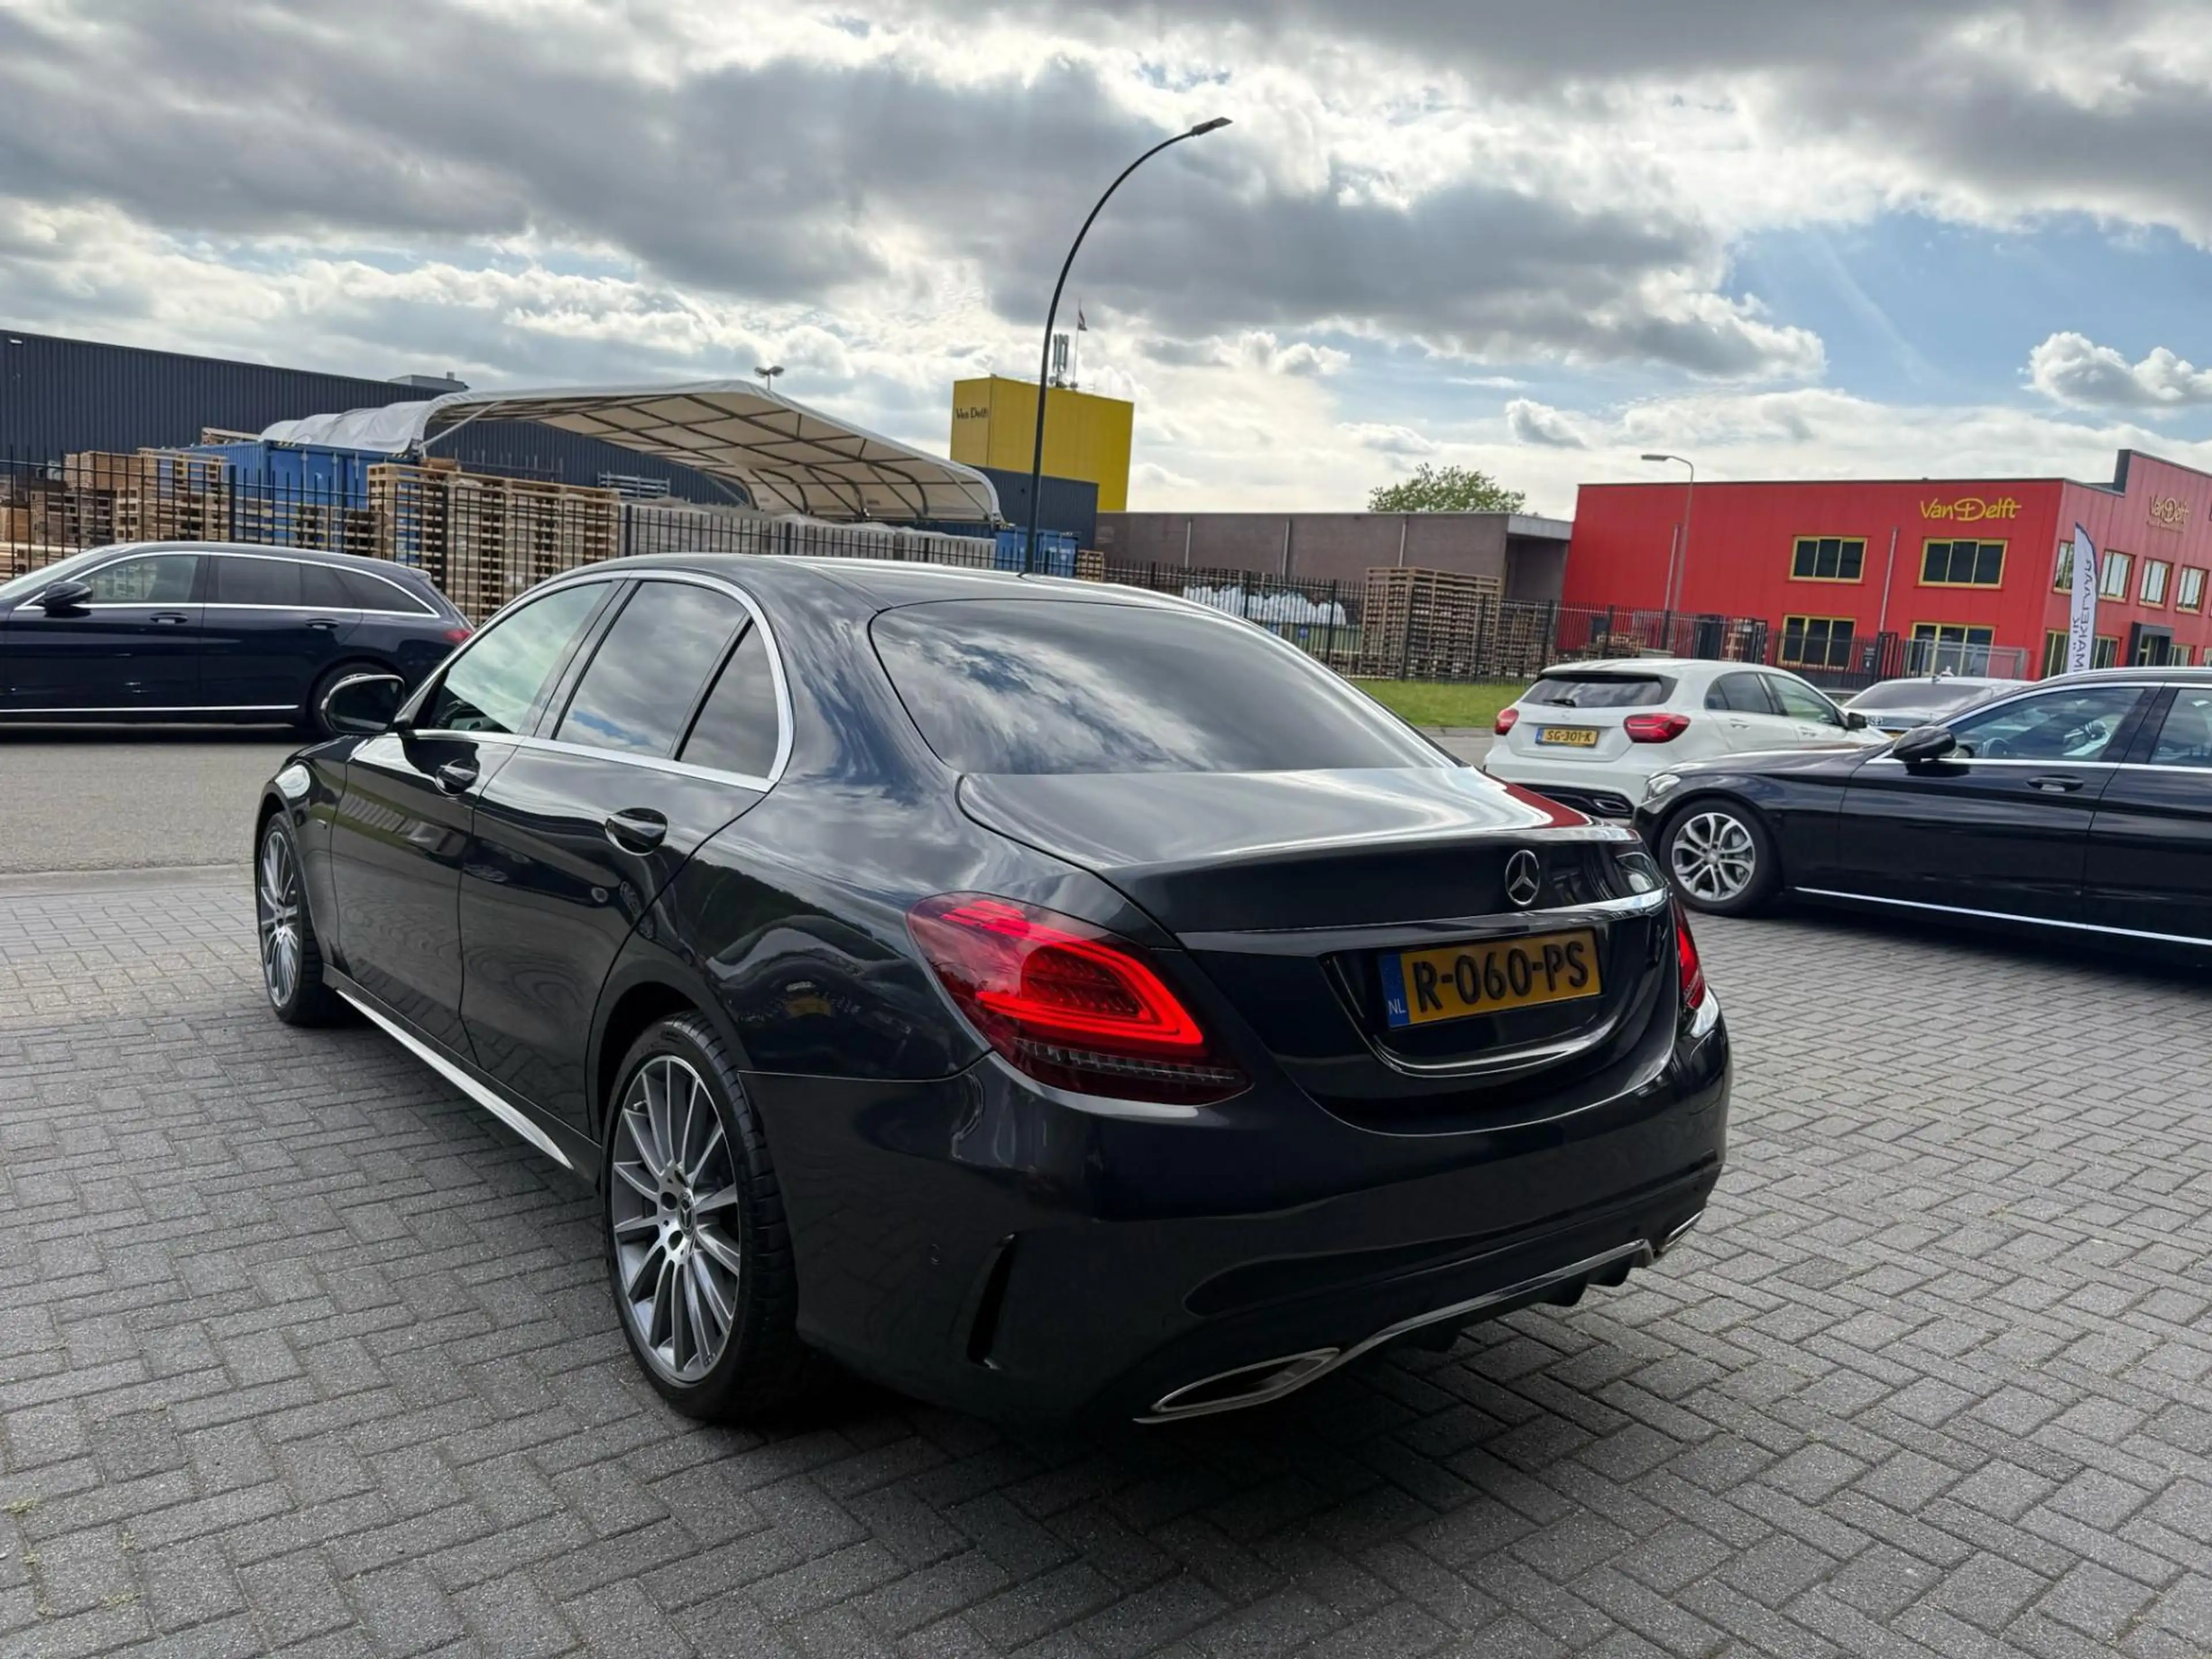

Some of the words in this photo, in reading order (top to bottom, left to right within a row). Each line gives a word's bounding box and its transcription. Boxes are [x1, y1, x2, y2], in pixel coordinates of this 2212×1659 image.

[1546, 730, 1594, 742] SG-301-K
[1412, 941, 1589, 1013] R-060-PS
[1388, 998, 1407, 1014] NL
